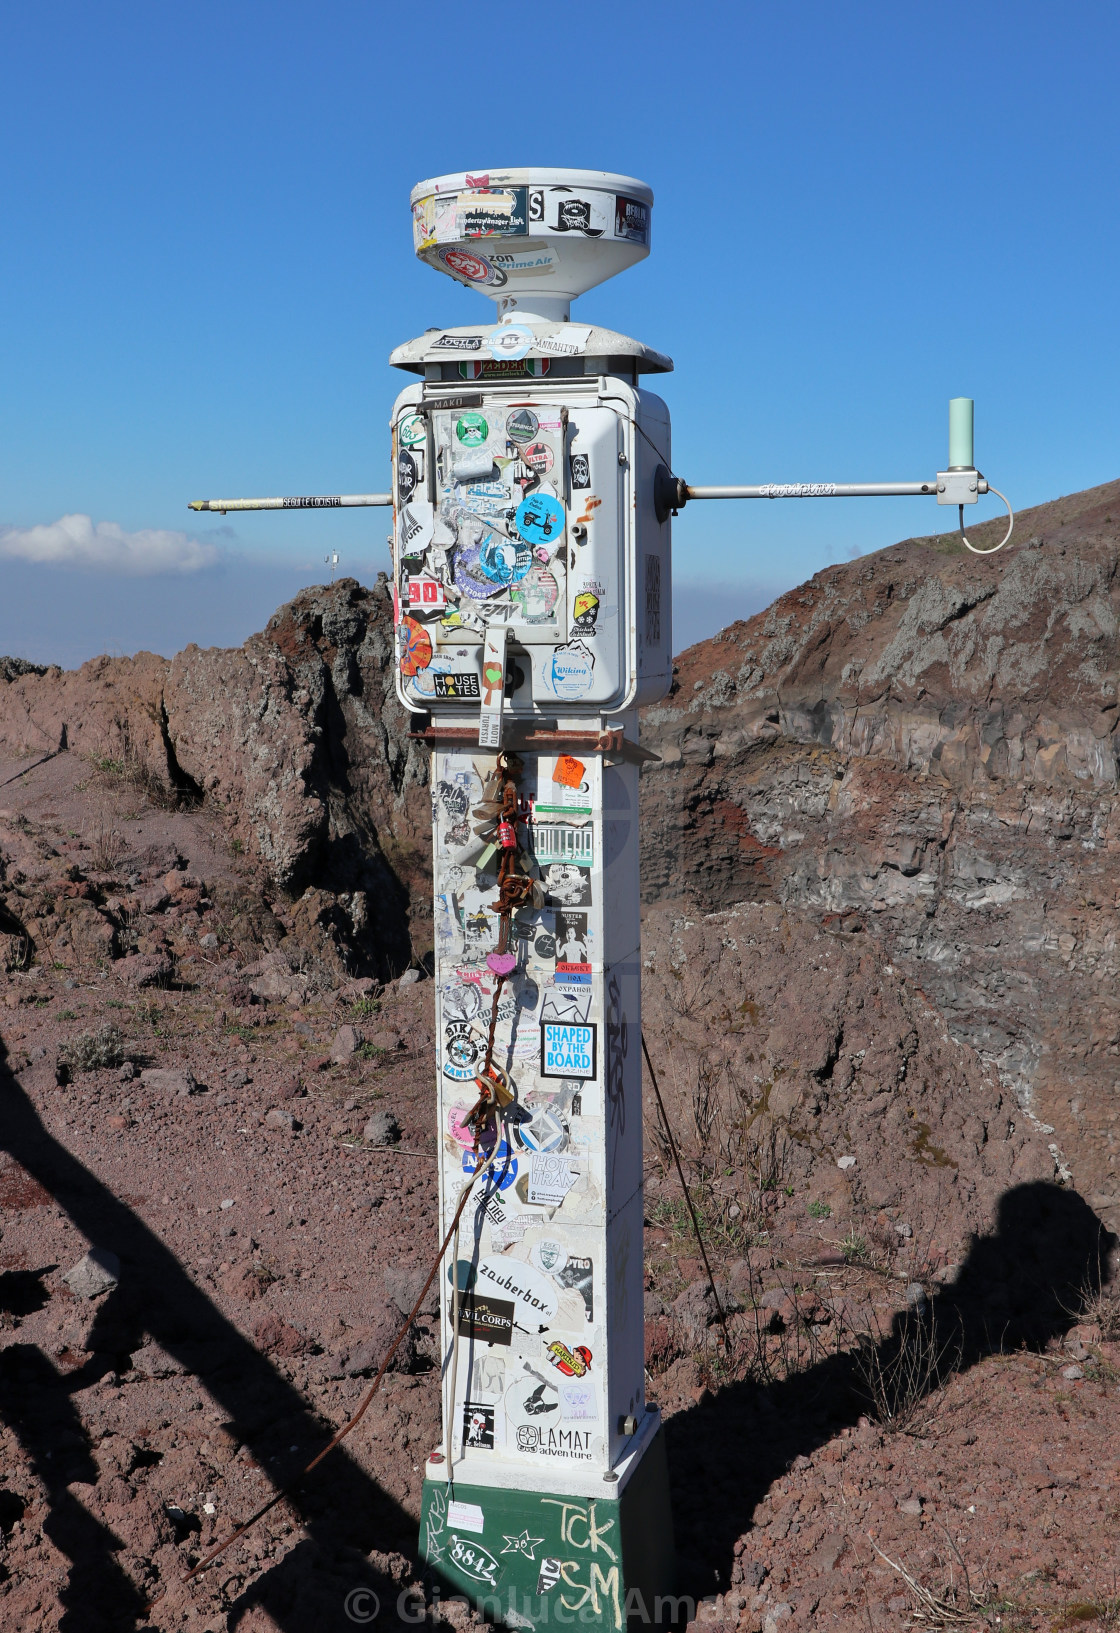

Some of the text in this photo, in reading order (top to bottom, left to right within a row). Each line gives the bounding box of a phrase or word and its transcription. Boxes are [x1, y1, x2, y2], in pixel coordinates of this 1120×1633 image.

[498, 256, 553, 270] Prime Air
[537, 338, 580, 354] ANNAHITA
[556, 666, 587, 675] Wiking
[435, 675, 477, 686] HOUSE
[437, 686, 479, 695] MATES
[480, 716, 490, 744] TURYSTA
[491, 724, 500, 745] MOTO
[567, 974, 582, 983] ПОД
[558, 984, 592, 993] ОХРАНОЙ
[477, 998, 518, 1020] ODSSEY
[546, 1026, 591, 1043] SHAPED
[552, 1042, 586, 1053] BY THE
[547, 1052, 591, 1068] BOARD
[546, 1067, 591, 1075] MAGAZINE
[467, 1155, 515, 1176] NSA
[566, 1258, 591, 1270] PYRO
[479, 1264, 549, 1313] zauberbox
[481, 1314, 512, 1328] CORPS
[539, 1426, 592, 1451] LAMAT
